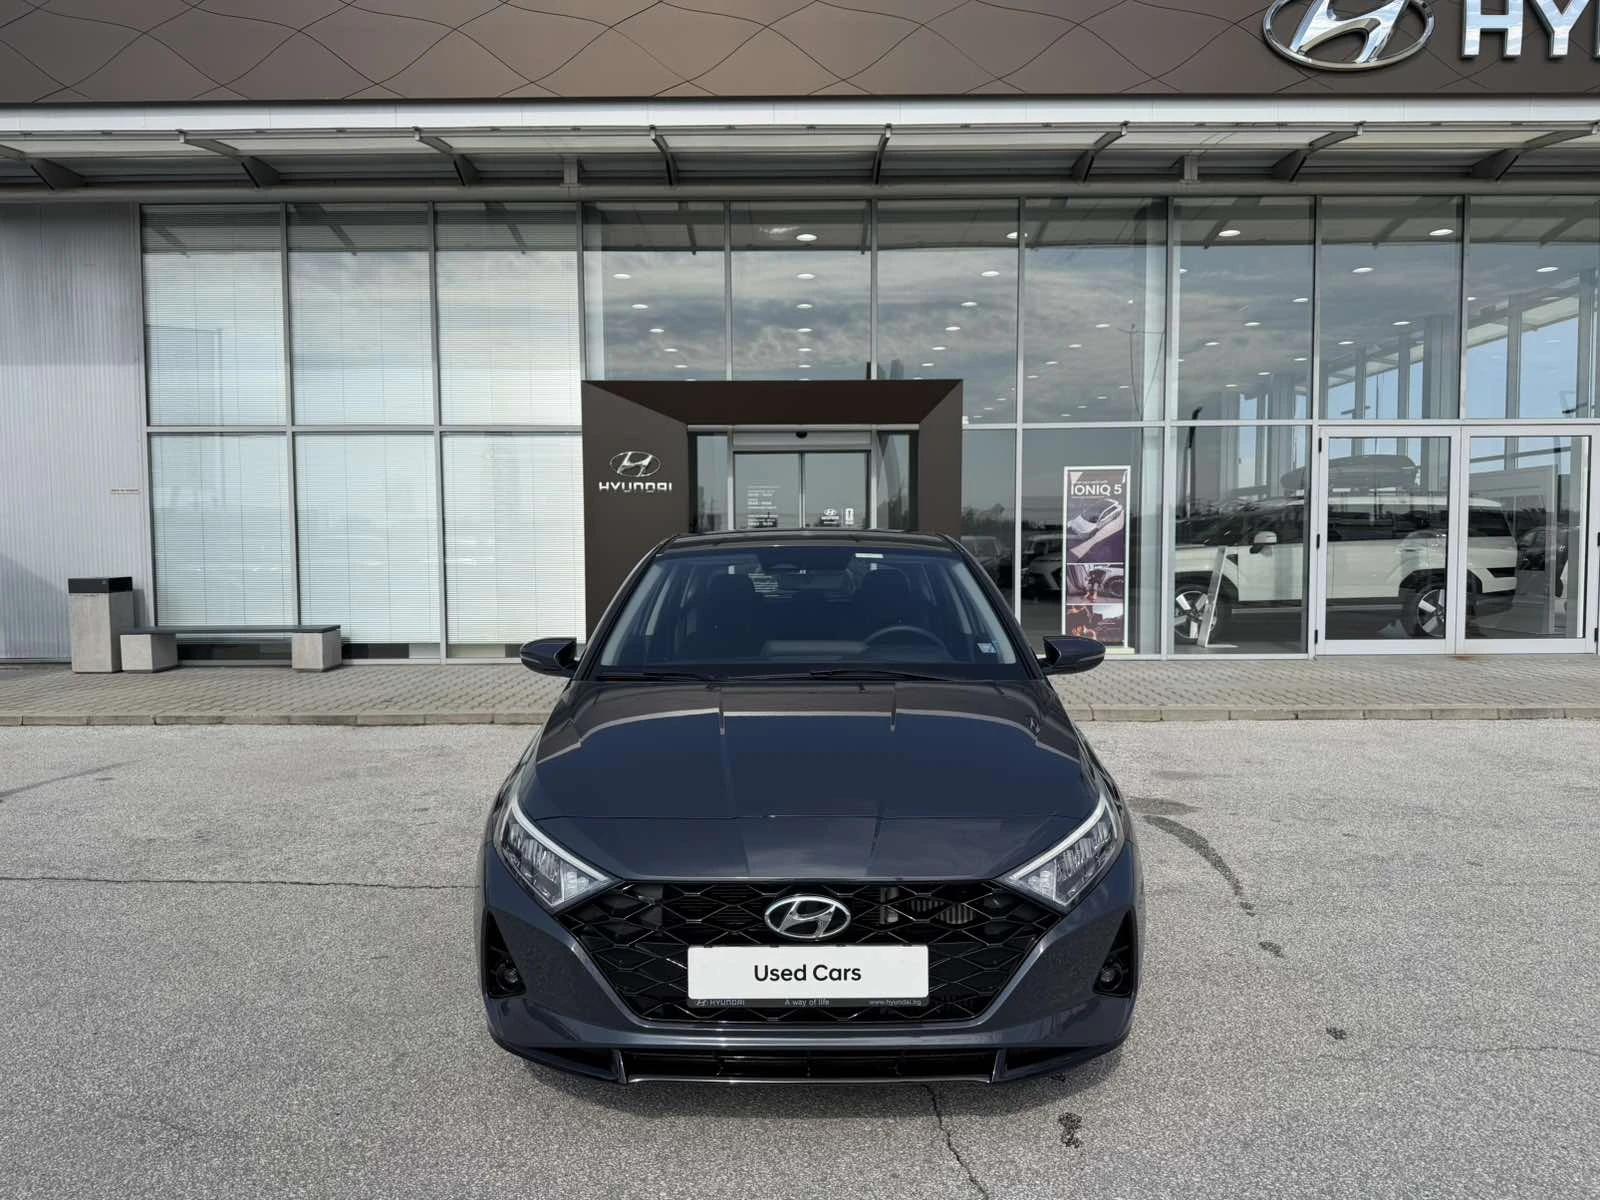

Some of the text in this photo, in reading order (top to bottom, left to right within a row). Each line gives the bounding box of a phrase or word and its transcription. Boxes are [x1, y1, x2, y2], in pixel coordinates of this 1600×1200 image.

[1461, 0, 1600, 59] HY
[598, 481, 673, 493] HYUNDAI
[1071, 484, 1122, 496] IONIQ 5
[754, 964, 862, 982] Used Cars
[709, 999, 745, 1007] HYUNDAI
